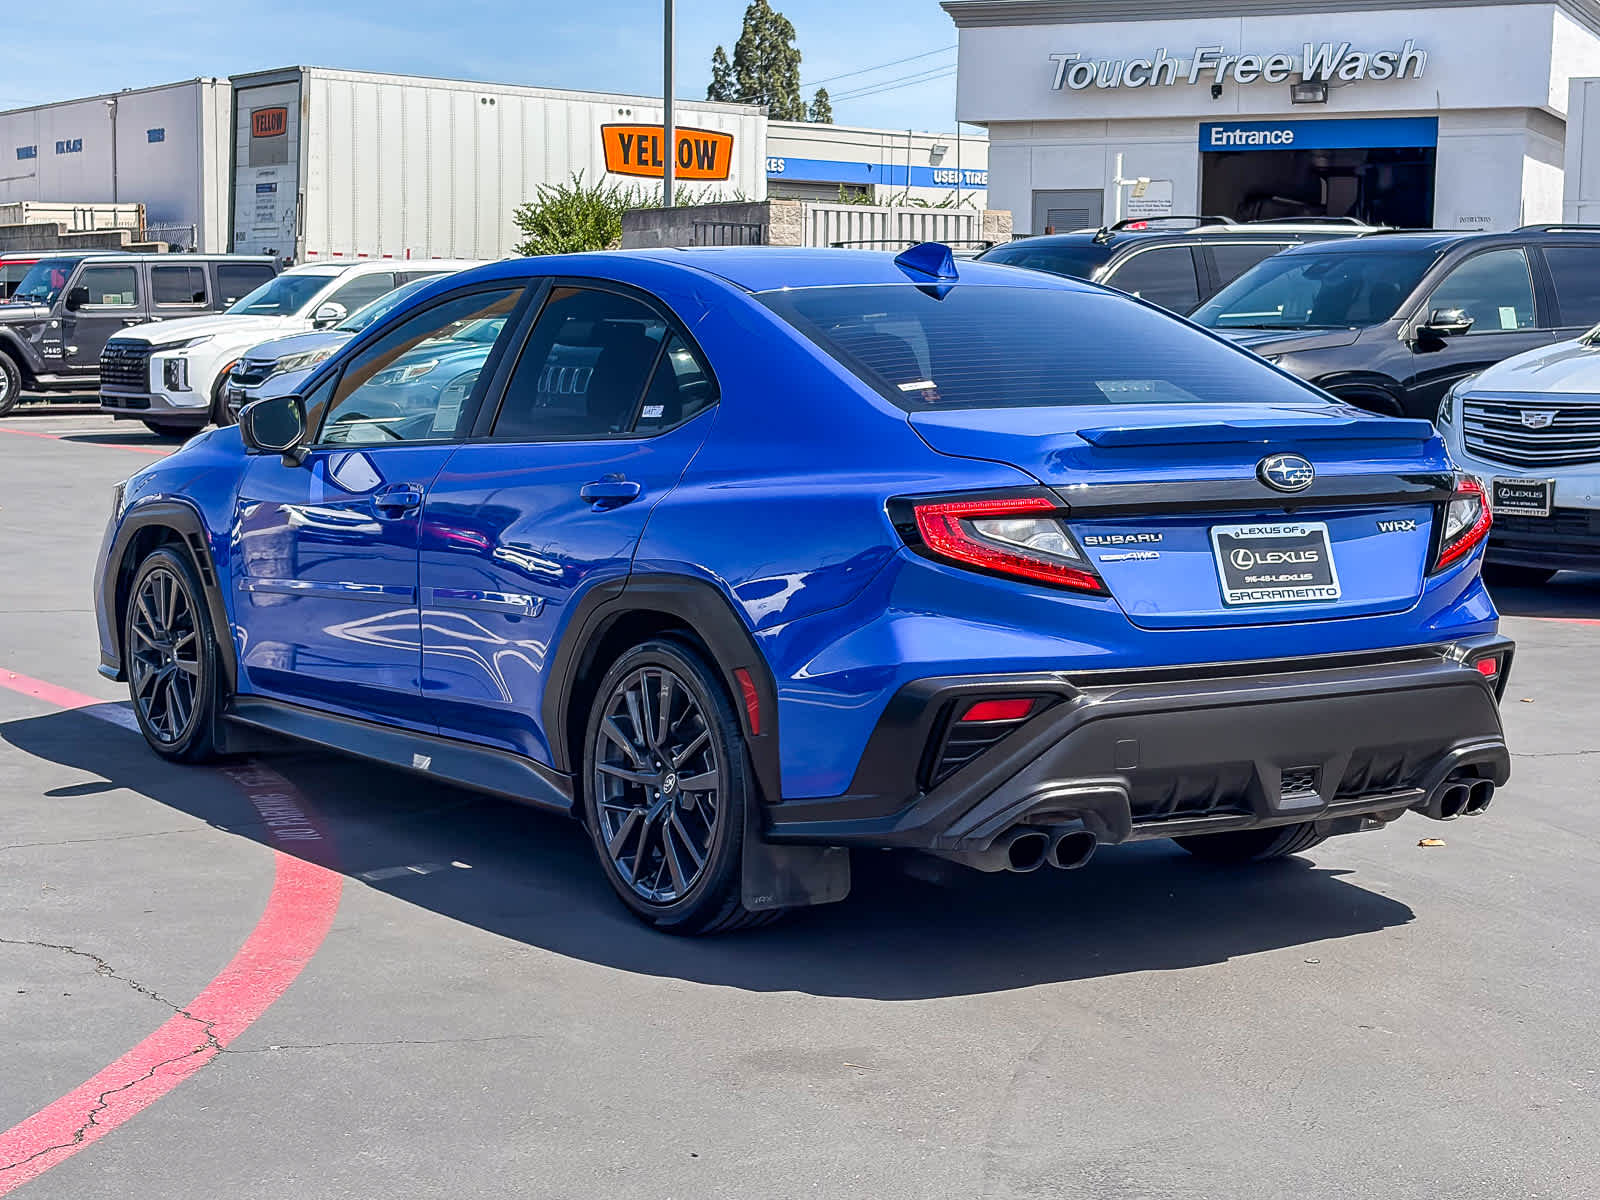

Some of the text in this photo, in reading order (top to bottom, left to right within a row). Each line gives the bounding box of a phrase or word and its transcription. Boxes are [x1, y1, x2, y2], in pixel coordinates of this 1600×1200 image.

[1048, 39, 1427, 91] Touch Free Wash
[256, 112, 283, 132] YELLOW
[1211, 127, 1294, 145] Entrance
[618, 132, 718, 171] YELOW
[933, 170, 963, 184] USED
[1510, 490, 1543, 498] LEXUS
[1240, 526, 1299, 535] LEXUS OF
[1377, 519, 1416, 532] WRX
[1084, 533, 1163, 545] SUBARU
[1255, 550, 1319, 564] LEXUS
[1230, 587, 1337, 601] SACRAMENTO
